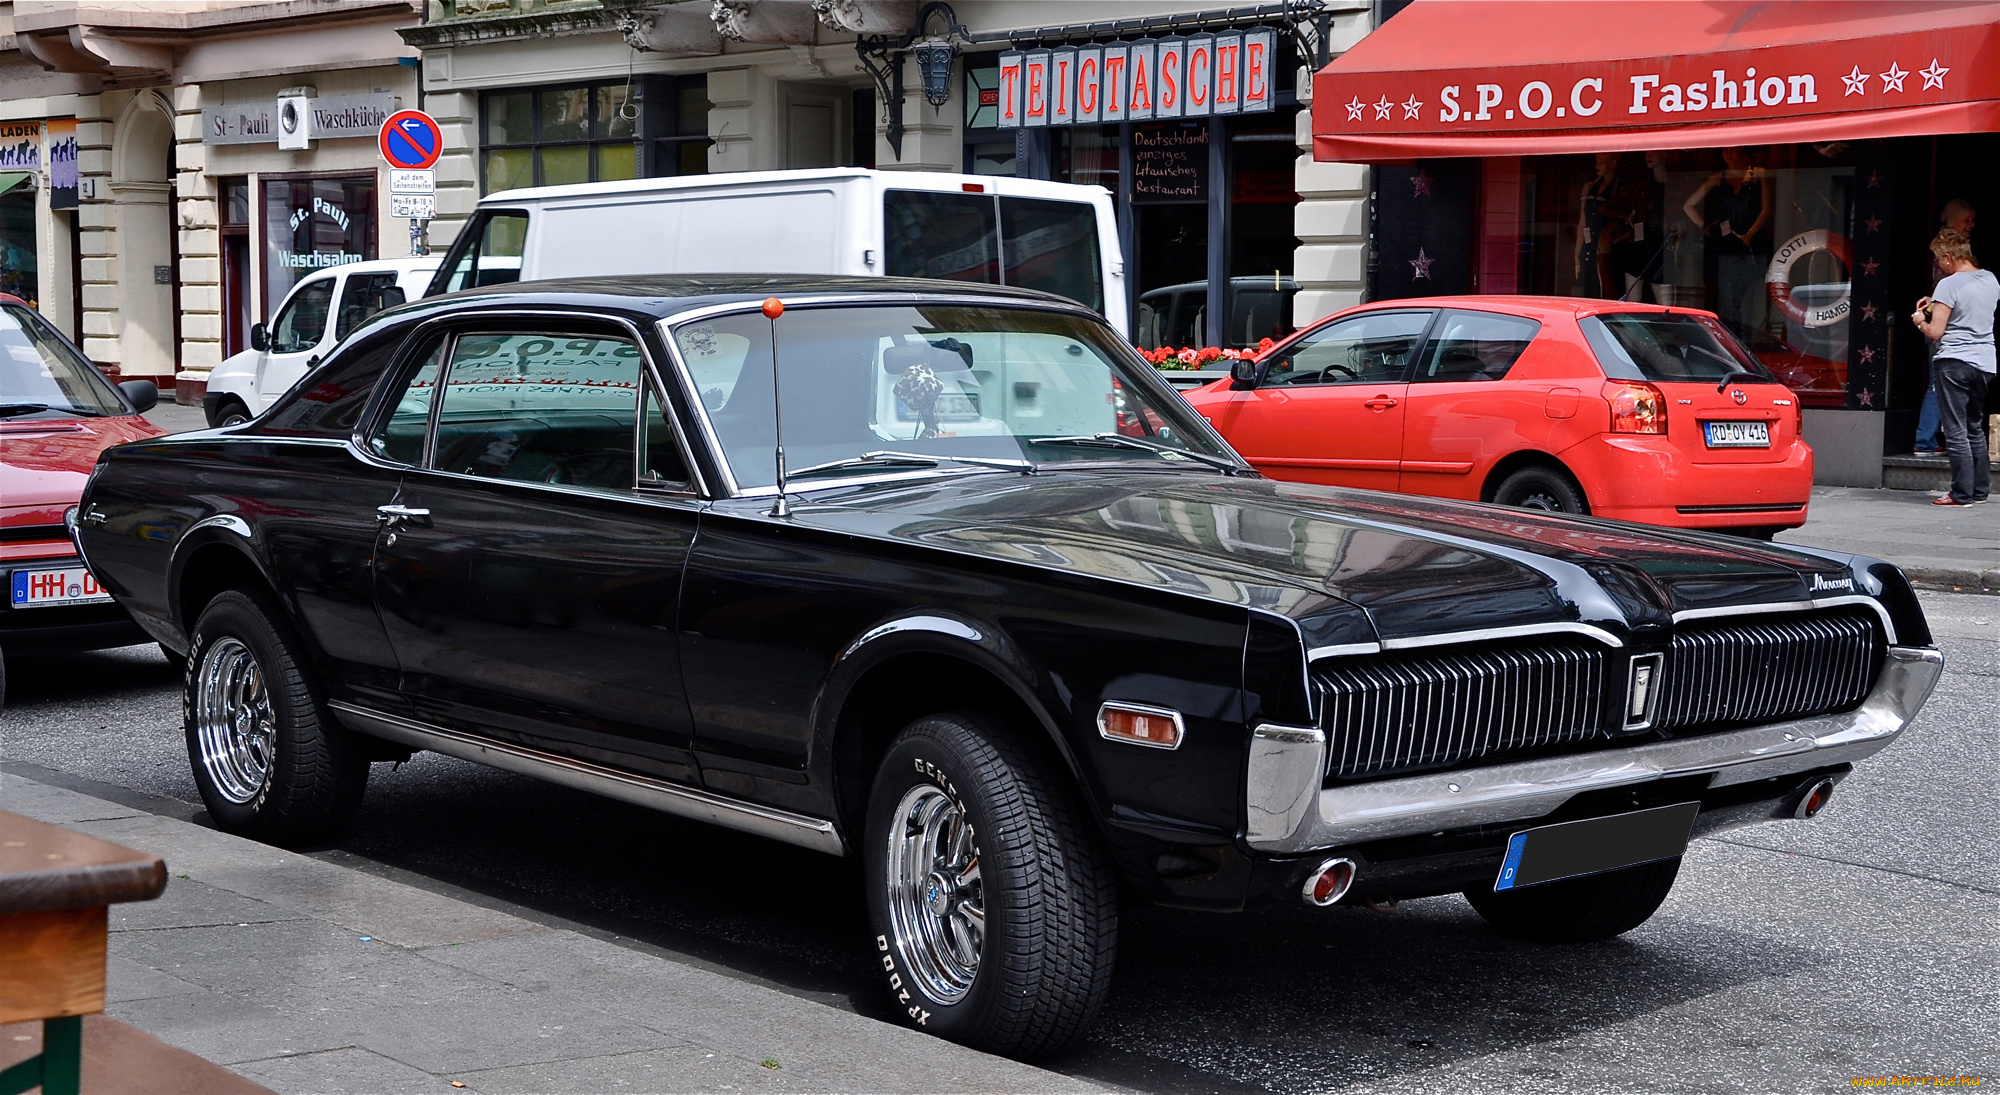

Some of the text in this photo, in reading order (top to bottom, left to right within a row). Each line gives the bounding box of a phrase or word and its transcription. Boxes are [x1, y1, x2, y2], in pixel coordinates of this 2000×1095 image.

[1001, 43, 1265, 118] TEIGTASCHE
[1440, 67, 1818, 122] S.P.O.C Fashion
[238, 113, 269, 135] Pauli
[314, 106, 386, 132] Waschküche
[1, 126, 38, 137] LADEN
[1135, 127, 1209, 145] Deutschlands
[1137, 151, 1186, 166] einziges
[1135, 161, 1197, 177] Litauisches
[1137, 179, 1200, 195] Restaurant
[290, 197, 349, 232] St. Pauli
[1777, 237, 1807, 264] LOTTI
[1711, 424, 1726, 440] RD
[1733, 424, 1745, 440] OY
[1748, 424, 1767, 440] 416
[31, 573, 65, 598] HH
[1810, 573, 1854, 592] Mercury
[1505, 868, 1513, 879] D
